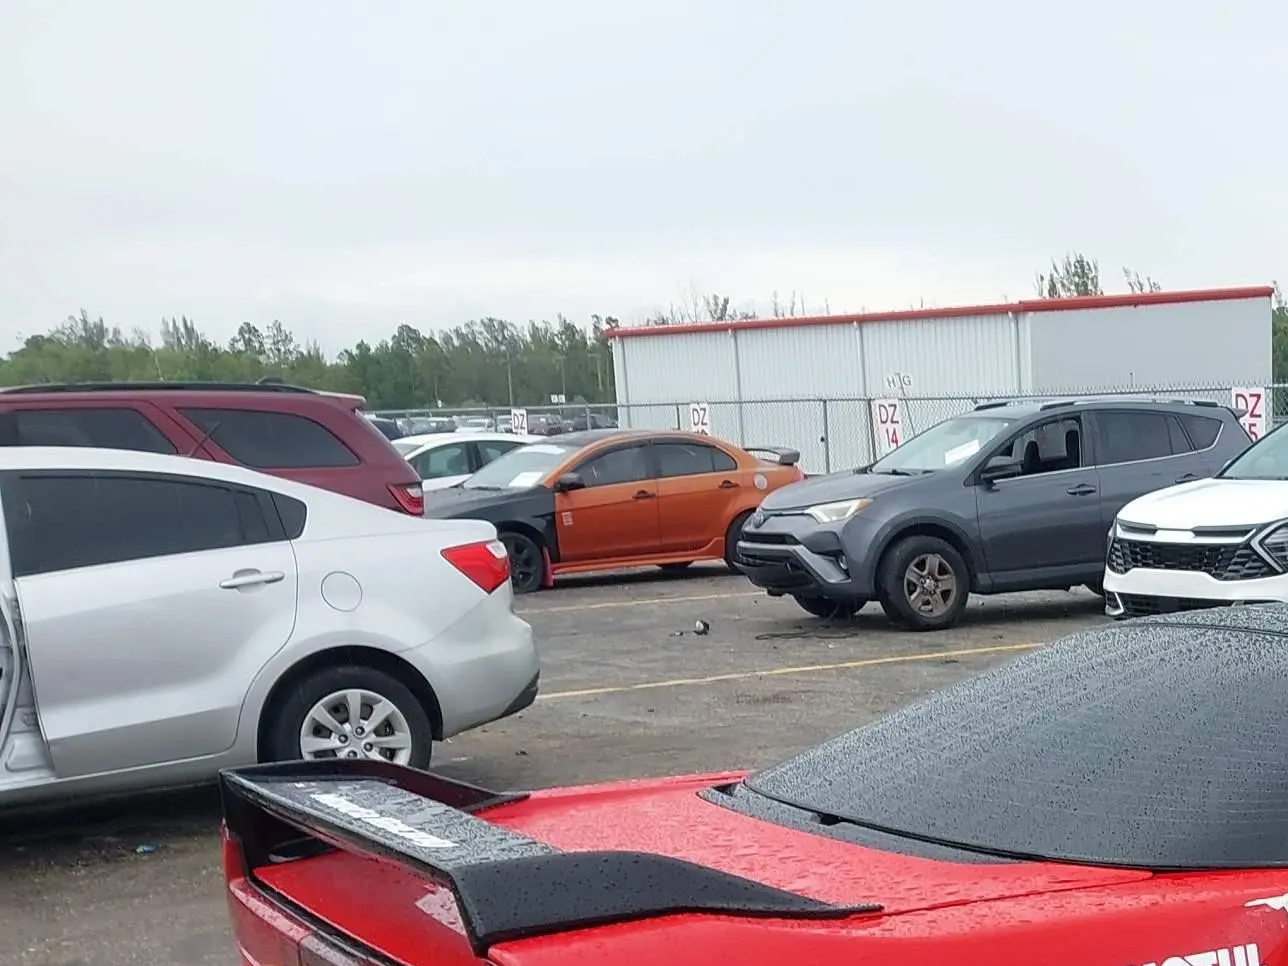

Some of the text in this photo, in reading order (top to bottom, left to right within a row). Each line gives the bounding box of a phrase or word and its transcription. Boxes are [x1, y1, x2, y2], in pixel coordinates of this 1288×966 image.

[878, 404, 900, 424] DZ
[1235, 393, 1262, 418] DZ
[513, 413, 526, 430] DZ
[692, 408, 708, 426] DZ
[886, 428, 899, 448] 14
